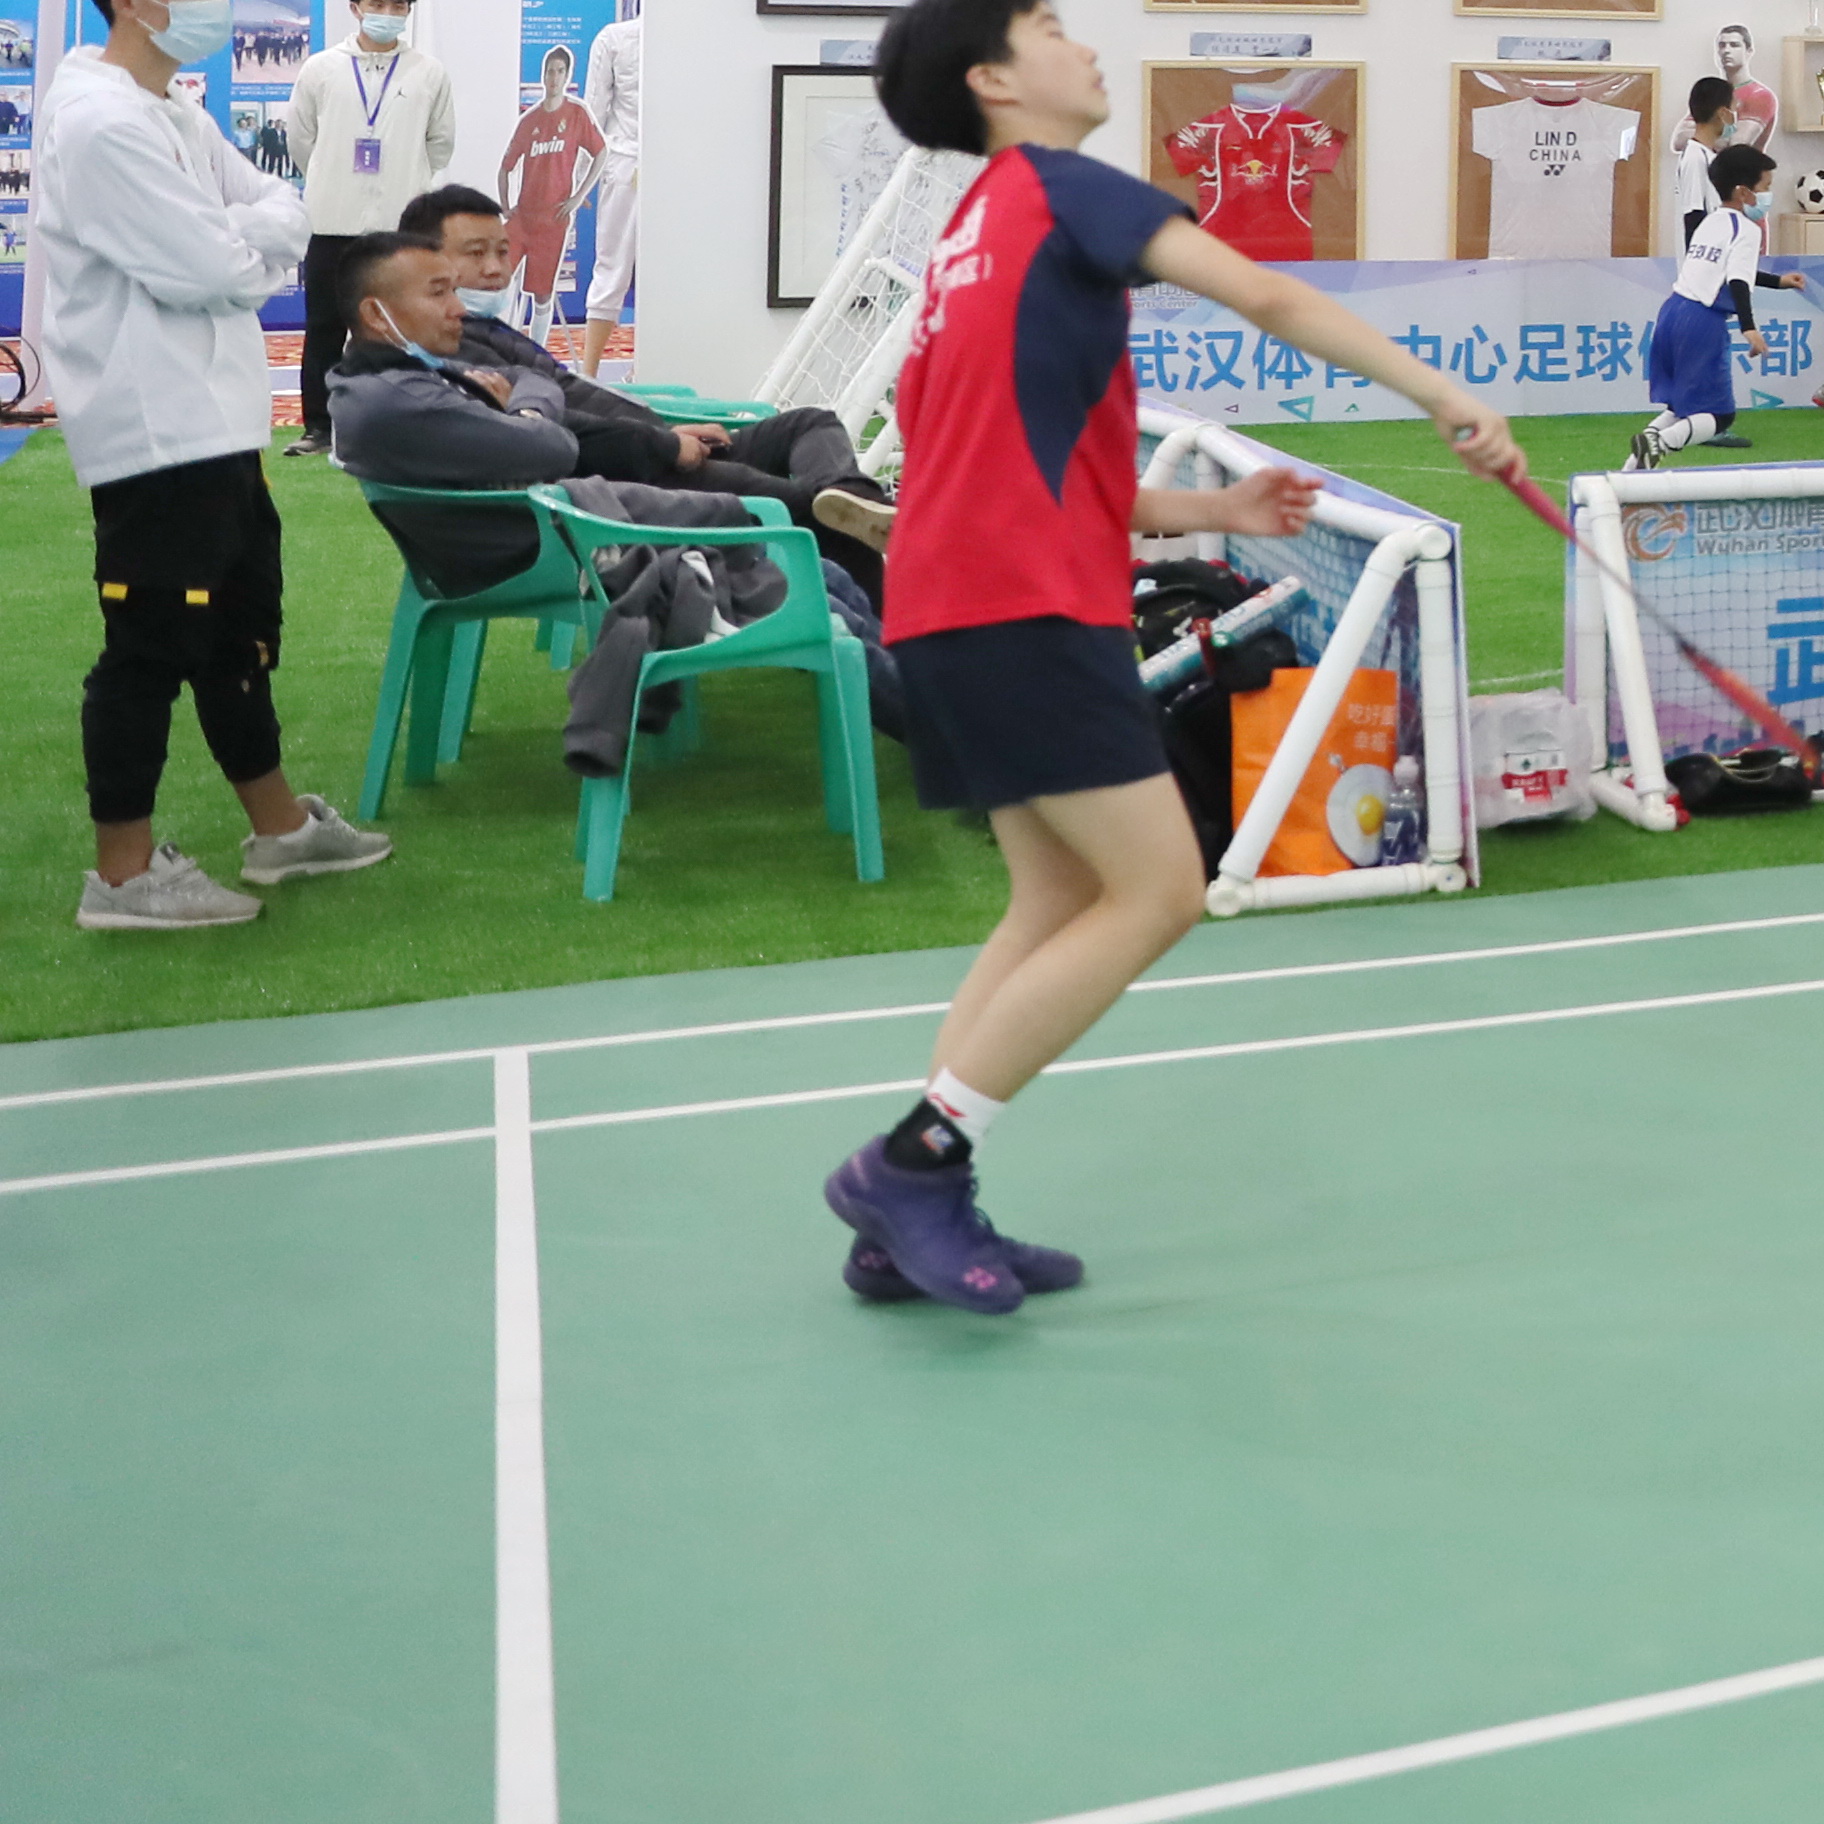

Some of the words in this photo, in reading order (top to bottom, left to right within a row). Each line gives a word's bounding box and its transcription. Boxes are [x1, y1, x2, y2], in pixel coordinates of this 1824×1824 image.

[1535, 131, 1561, 146] LIN
[1566, 131, 1577, 146] D
[529, 135, 566, 158] bwin
[1529, 149, 1582, 161] CHINA
[1158, 298, 1198, 309] Center
[1696, 535, 1769, 555] Wuhan
